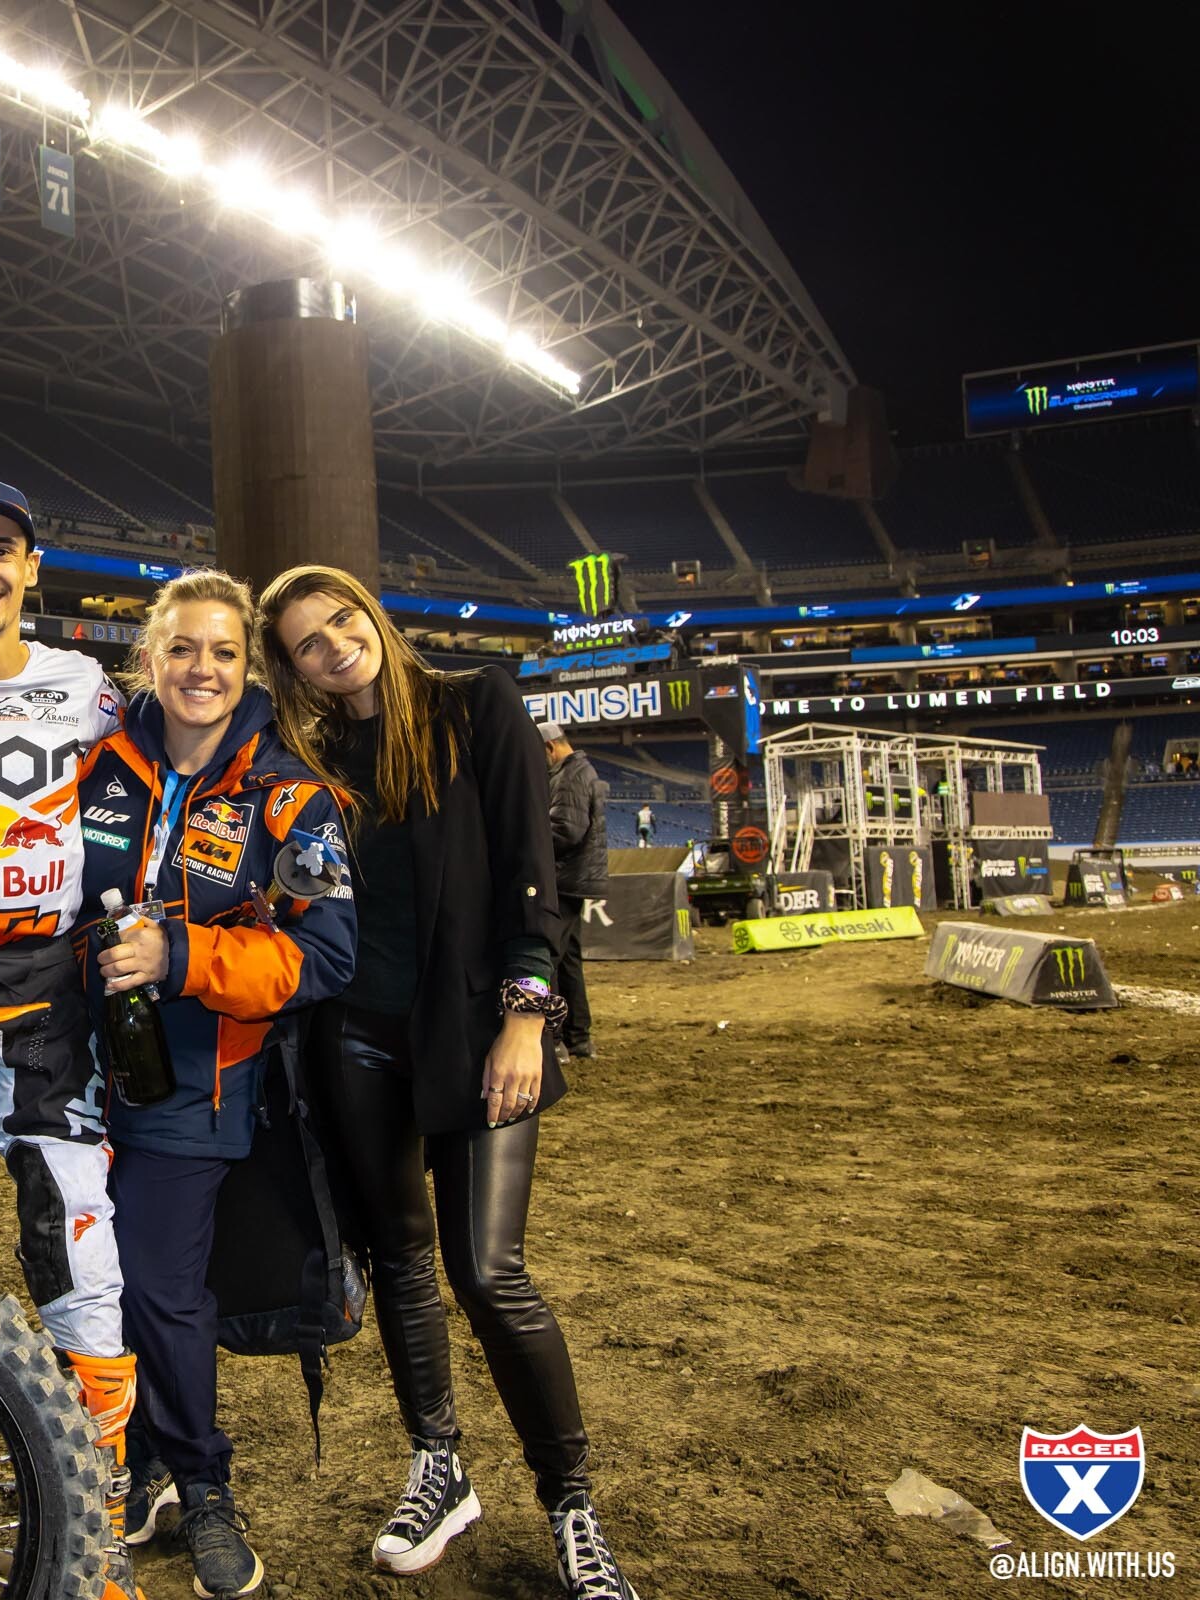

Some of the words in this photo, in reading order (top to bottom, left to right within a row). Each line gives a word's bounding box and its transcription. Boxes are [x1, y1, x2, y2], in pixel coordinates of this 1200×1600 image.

[46, 180, 70, 217] 71
[1066, 378, 1116, 392] MONSTER
[553, 618, 636, 643] MONSTER
[1111, 628, 1160, 646] 10:03
[566, 635, 624, 651] ENERGY
[517, 643, 672, 678] SUPERCROSS
[559, 665, 627, 683] Championship
[522, 680, 662, 727] FINISH
[831, 697, 865, 711] TO
[888, 689, 991, 710] LUMEN
[1016, 682, 1111, 702] FIELD
[31, 705, 80, 724] PARADISE
[83, 805, 131, 825] WP
[190, 812, 219, 837] Red
[217, 822, 246, 843] Bull
[84, 829, 127, 848] MOTOREX
[189, 839, 232, 862] KTM
[3, 859, 65, 897] Bull
[207, 866, 233, 882] RACING
[804, 917, 895, 938] Kawasaki
[951, 939, 1006, 972] MONSTER
[1050, 989, 1098, 999] MONSTER
